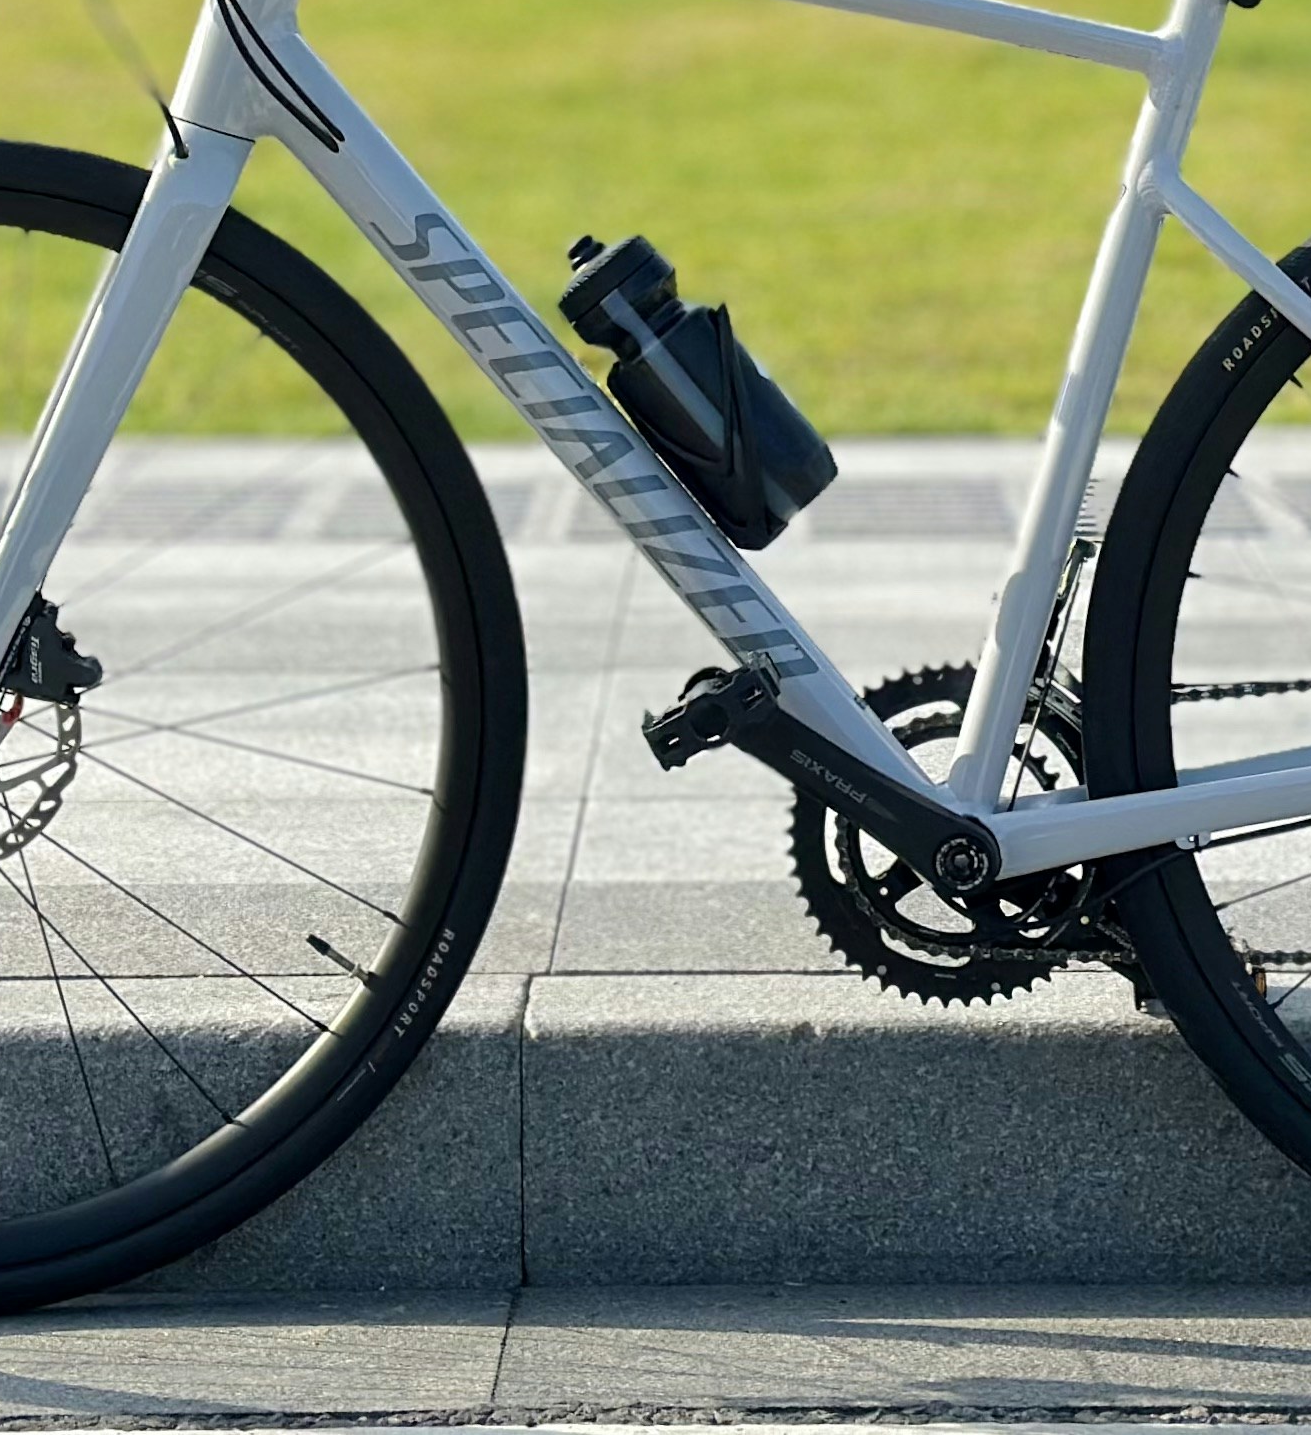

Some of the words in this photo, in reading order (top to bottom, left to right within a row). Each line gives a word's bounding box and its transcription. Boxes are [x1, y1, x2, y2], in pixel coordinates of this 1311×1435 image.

[370, 212, 820, 680] SPECIALIZED
[28, 635, 40, 684] Tiagra
[790, 748, 869, 804] PRAXIS
[393, 927, 456, 1039] ROADSPORT
